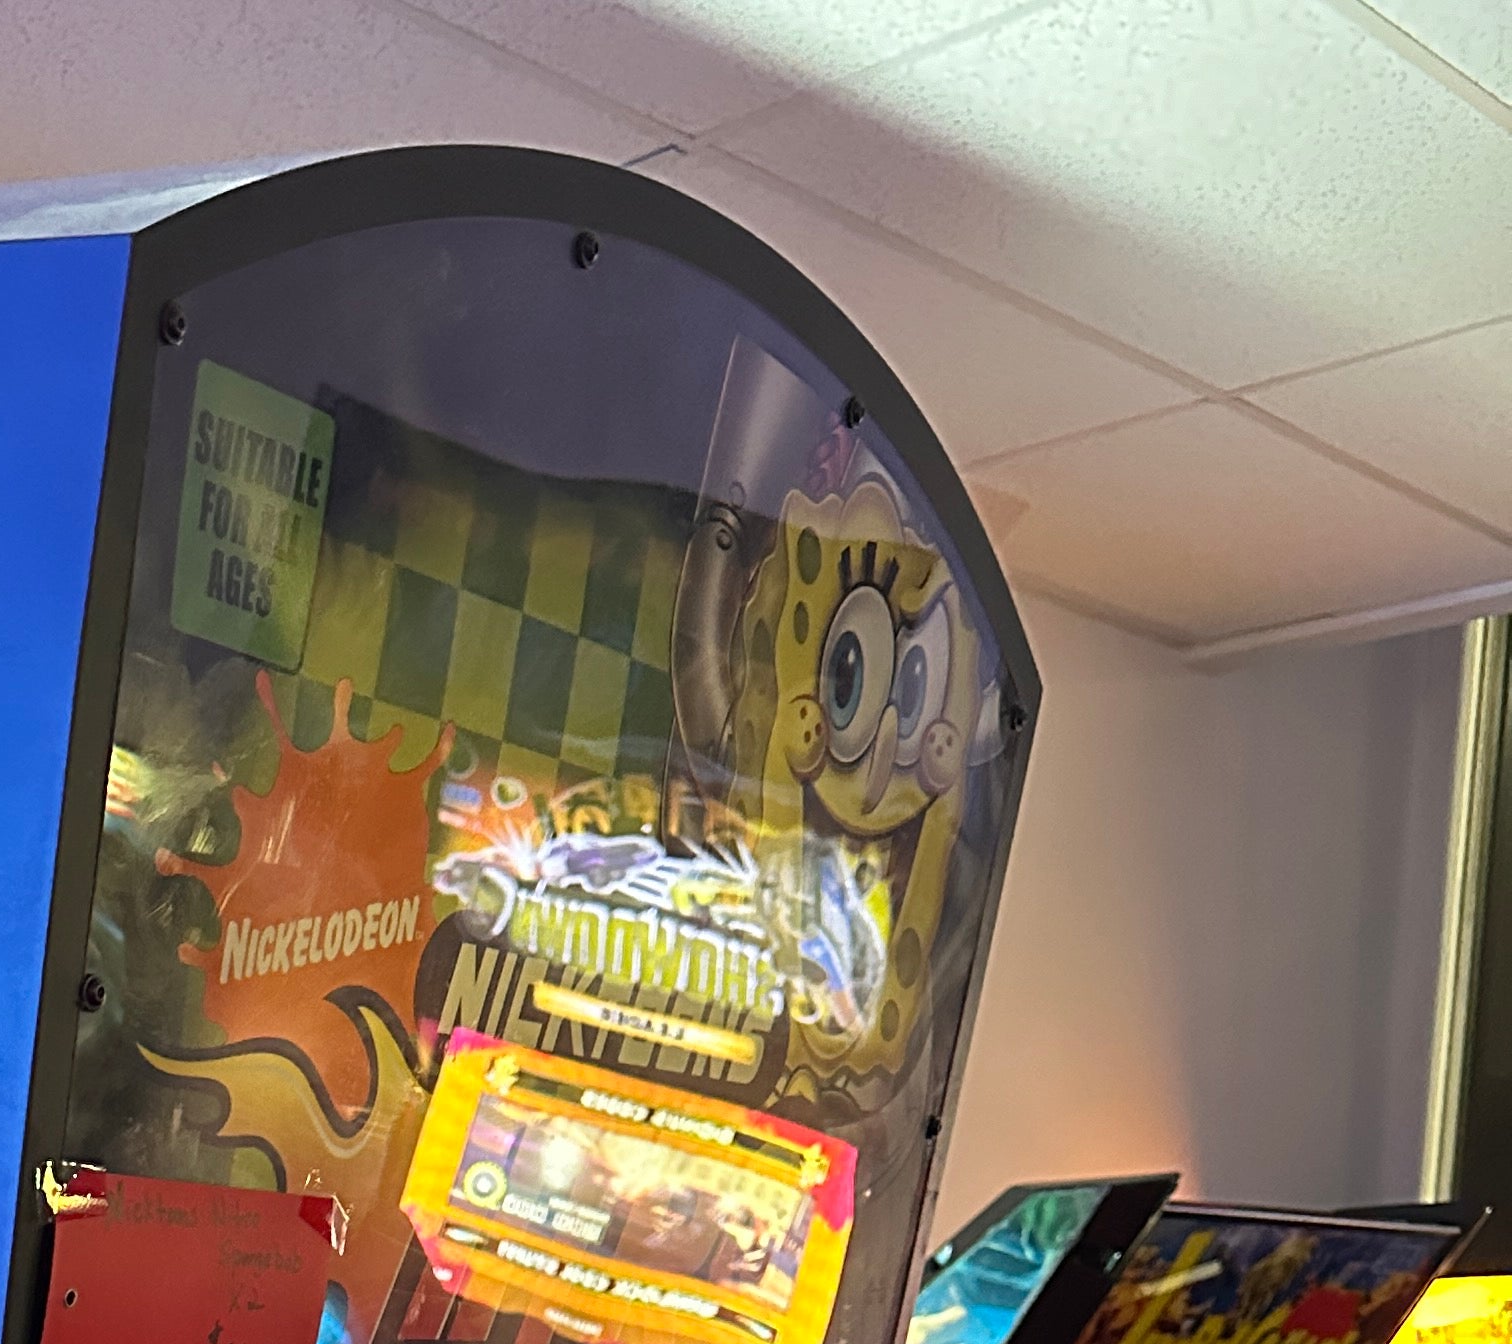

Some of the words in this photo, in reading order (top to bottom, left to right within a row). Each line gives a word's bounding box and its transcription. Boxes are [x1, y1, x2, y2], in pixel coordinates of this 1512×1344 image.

[194, 409, 324, 508] SUITABLE
[199, 480, 251, 548] FOR
[206, 549, 278, 618] AGES
